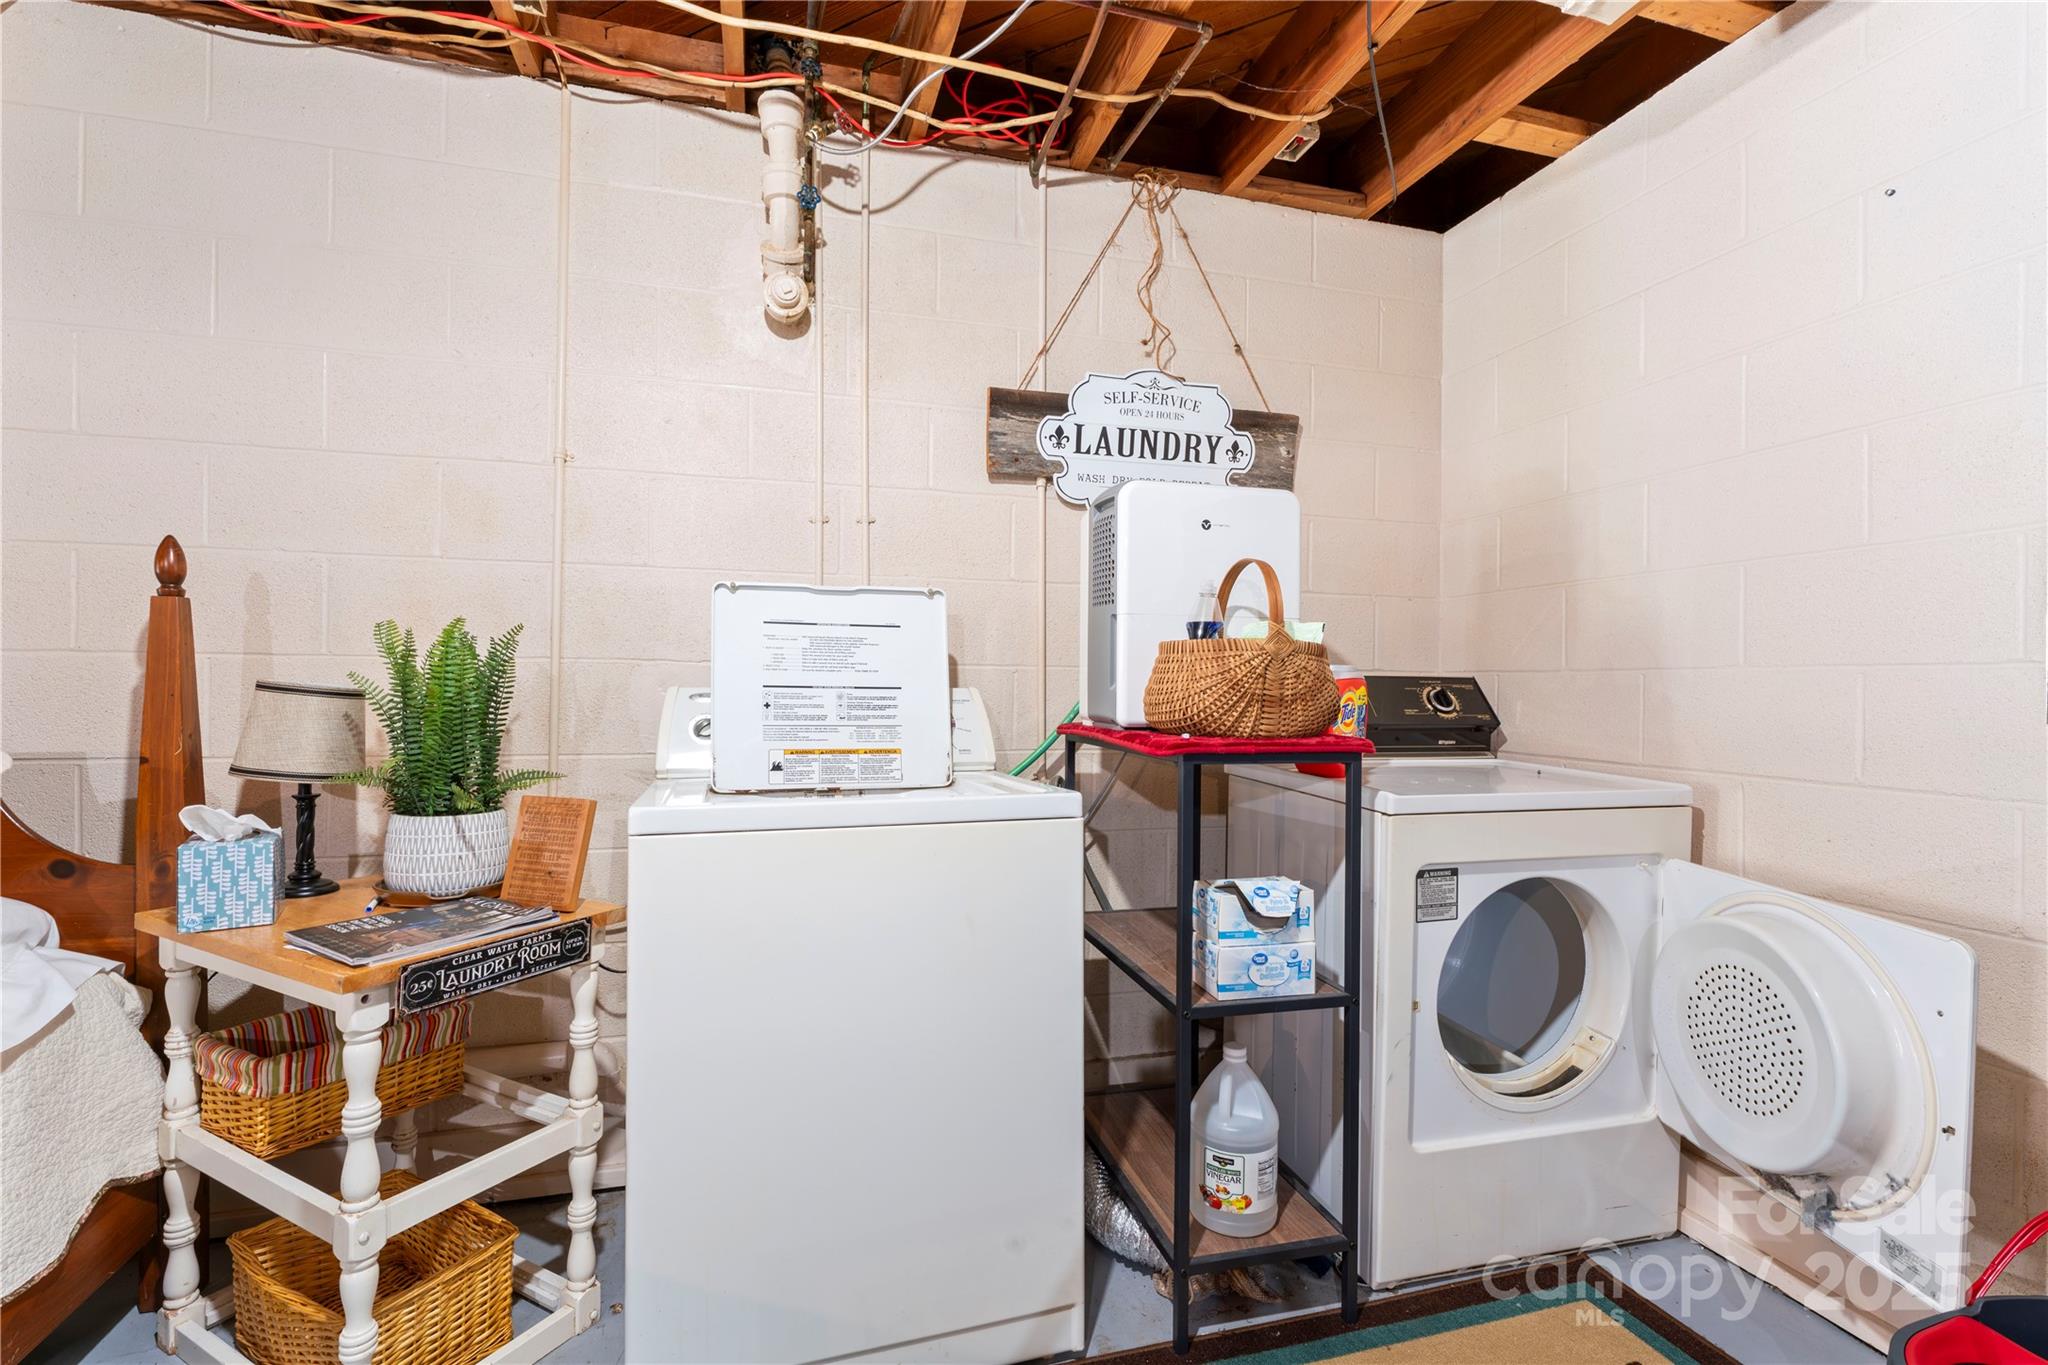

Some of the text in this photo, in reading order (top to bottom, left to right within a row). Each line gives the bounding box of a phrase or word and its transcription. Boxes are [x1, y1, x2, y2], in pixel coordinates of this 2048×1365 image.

[1103, 391, 1202, 413] SELF-SERVICE
[1119, 408, 1185, 421] OPEN 24 HOURS
[1073, 423, 1223, 465] LAUNDRY
[1077, 473, 1106, 484] WASH
[1340, 702, 1356, 724] Tide
[452, 933, 553, 966] CLEAR WATER FARM'S
[566, 936, 582, 945] OPEN
[436, 941, 562, 991] LAUNDRY ROOM
[409, 978, 434, 996] 25¢
[443, 960, 558, 999] WASH DRY FOLD REPEAT
[1206, 1169, 1242, 1184] VINEGAR
